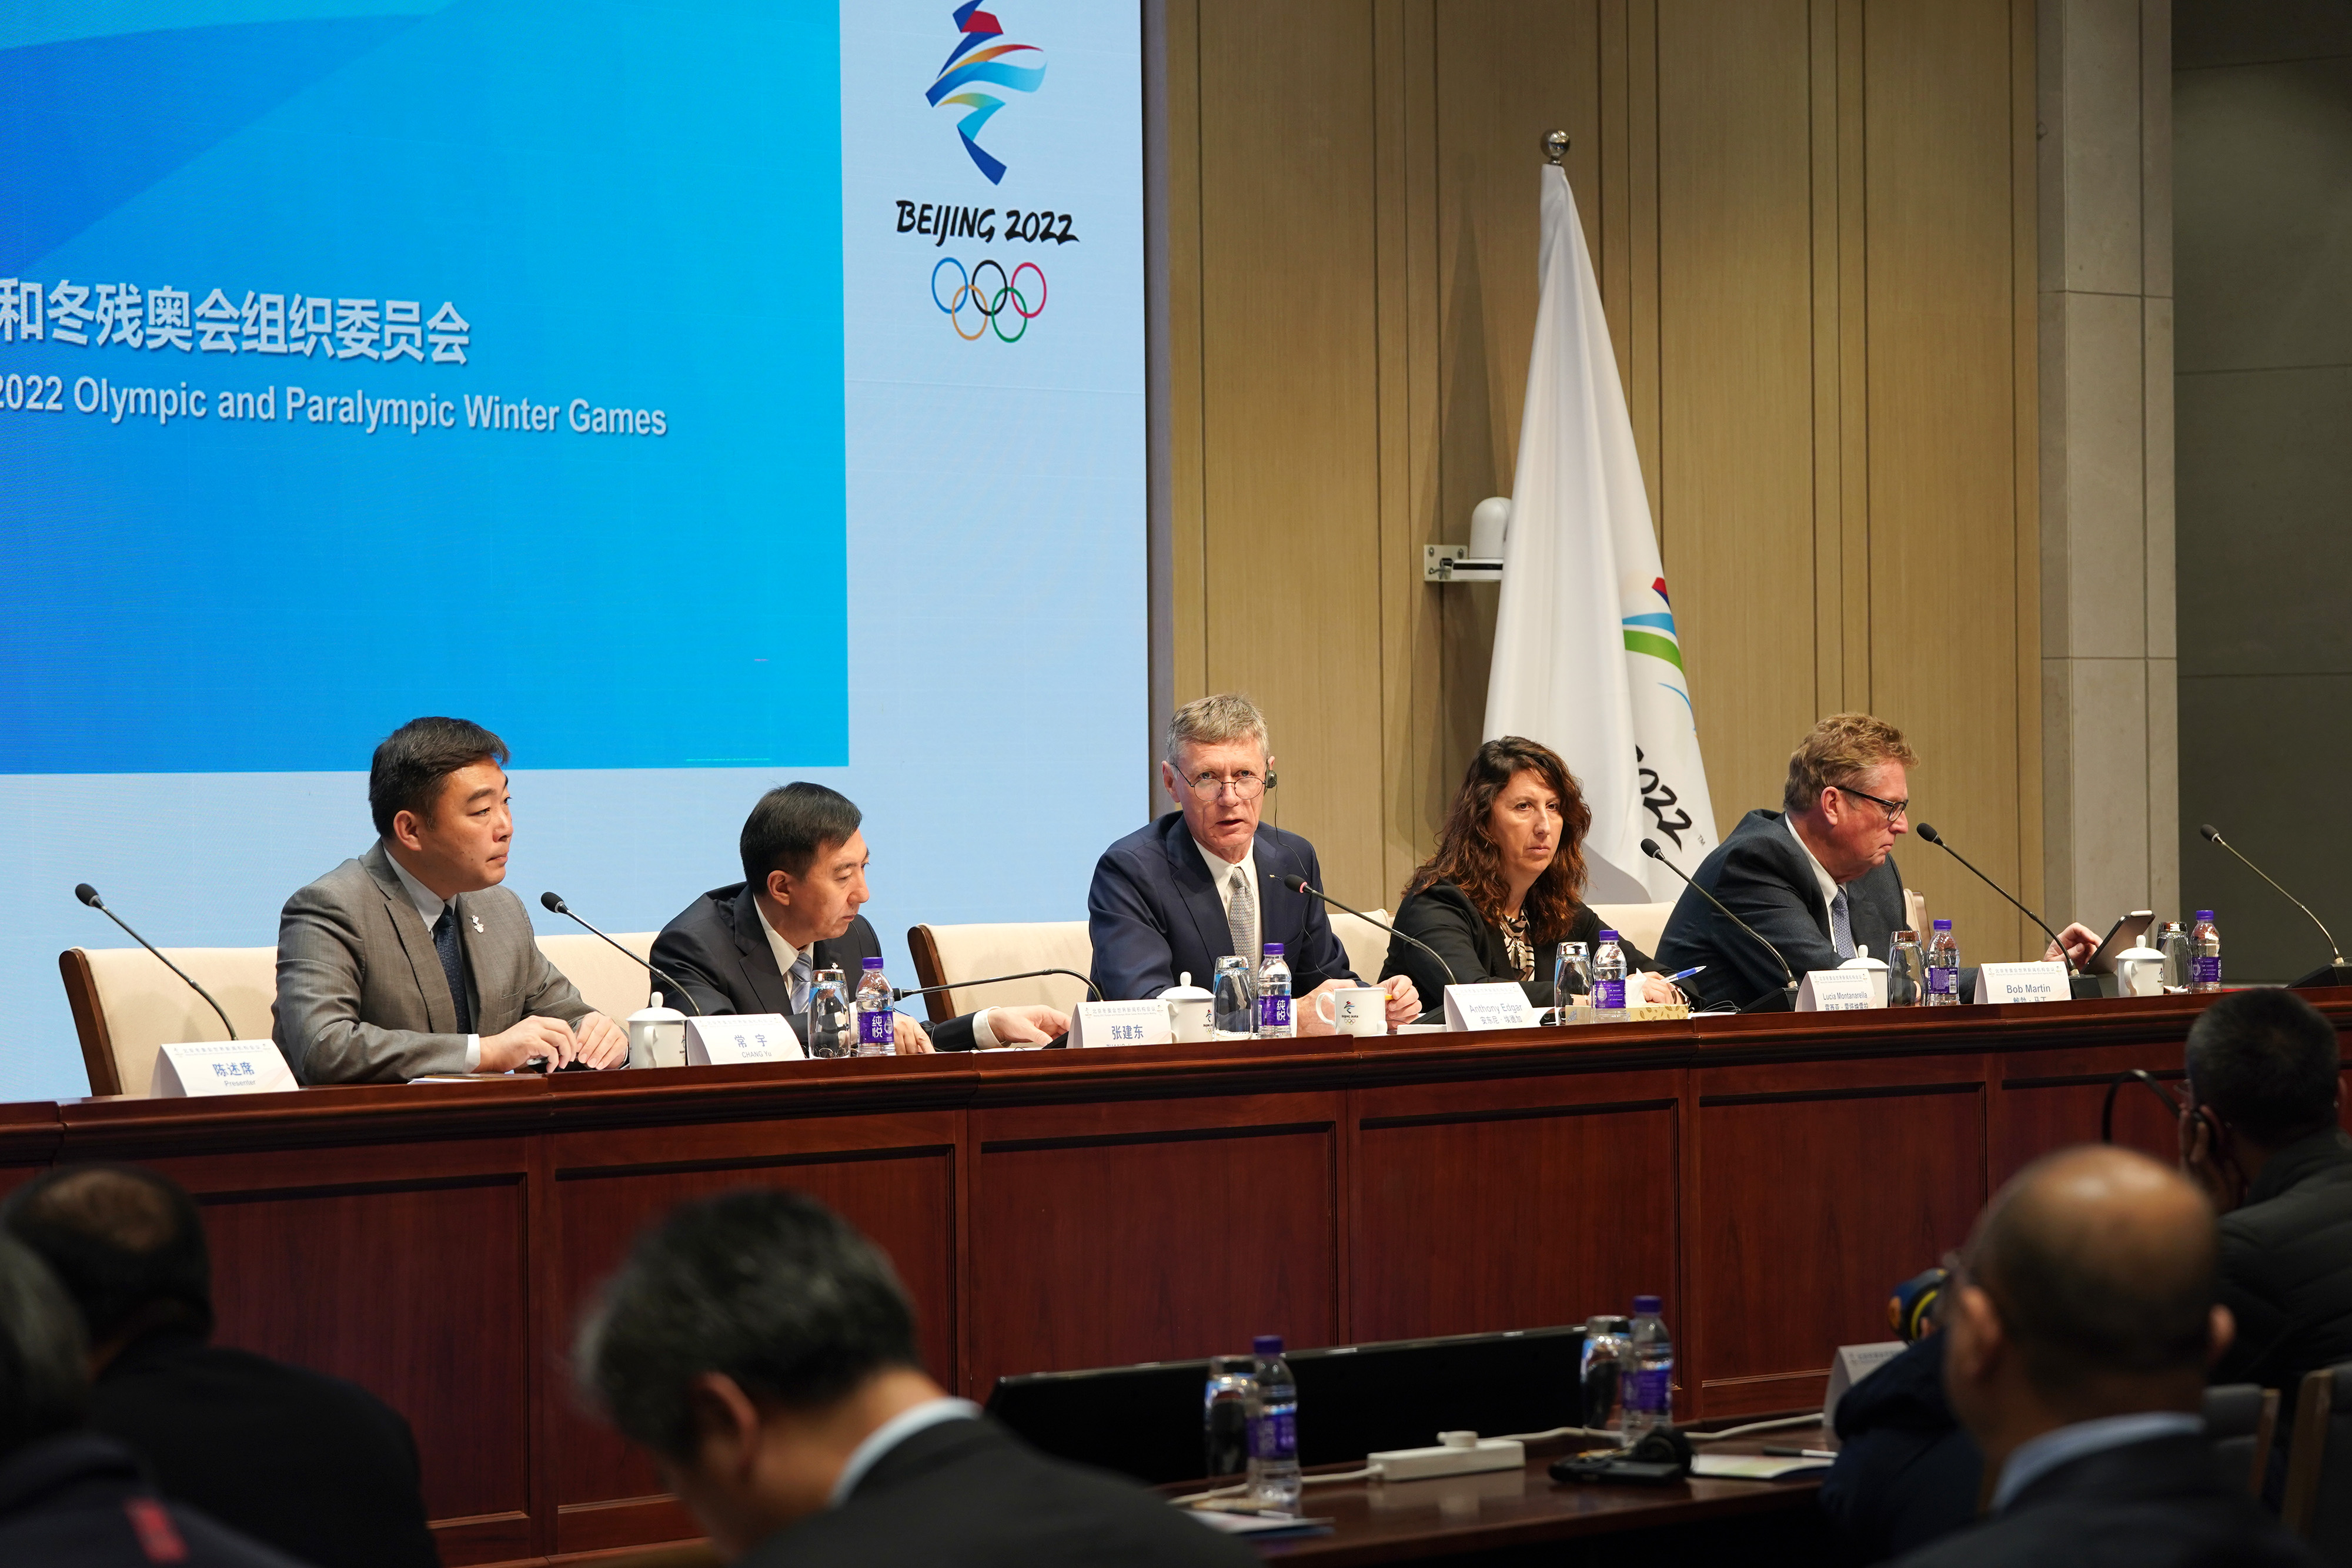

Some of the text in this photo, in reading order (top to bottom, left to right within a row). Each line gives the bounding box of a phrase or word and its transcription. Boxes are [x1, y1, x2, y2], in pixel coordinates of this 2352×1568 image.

[896, 200, 1080, 247] BEIJING 2022
[0, 277, 470, 365] 和冬残奥会组织委员会
[0, 373, 667, 434] 022 Olympic and Paralympic Winter Games
[2006, 984, 2051, 994] Bob Martin
[1277, 999, 1286, 1021] 纯悦
[1469, 1003, 1523, 1014] Anthony Edgar
[871, 1015, 883, 1038] 纯悦
[1111, 1025, 1144, 1040] 张建东
[212, 1062, 255, 1077] 陈述席
